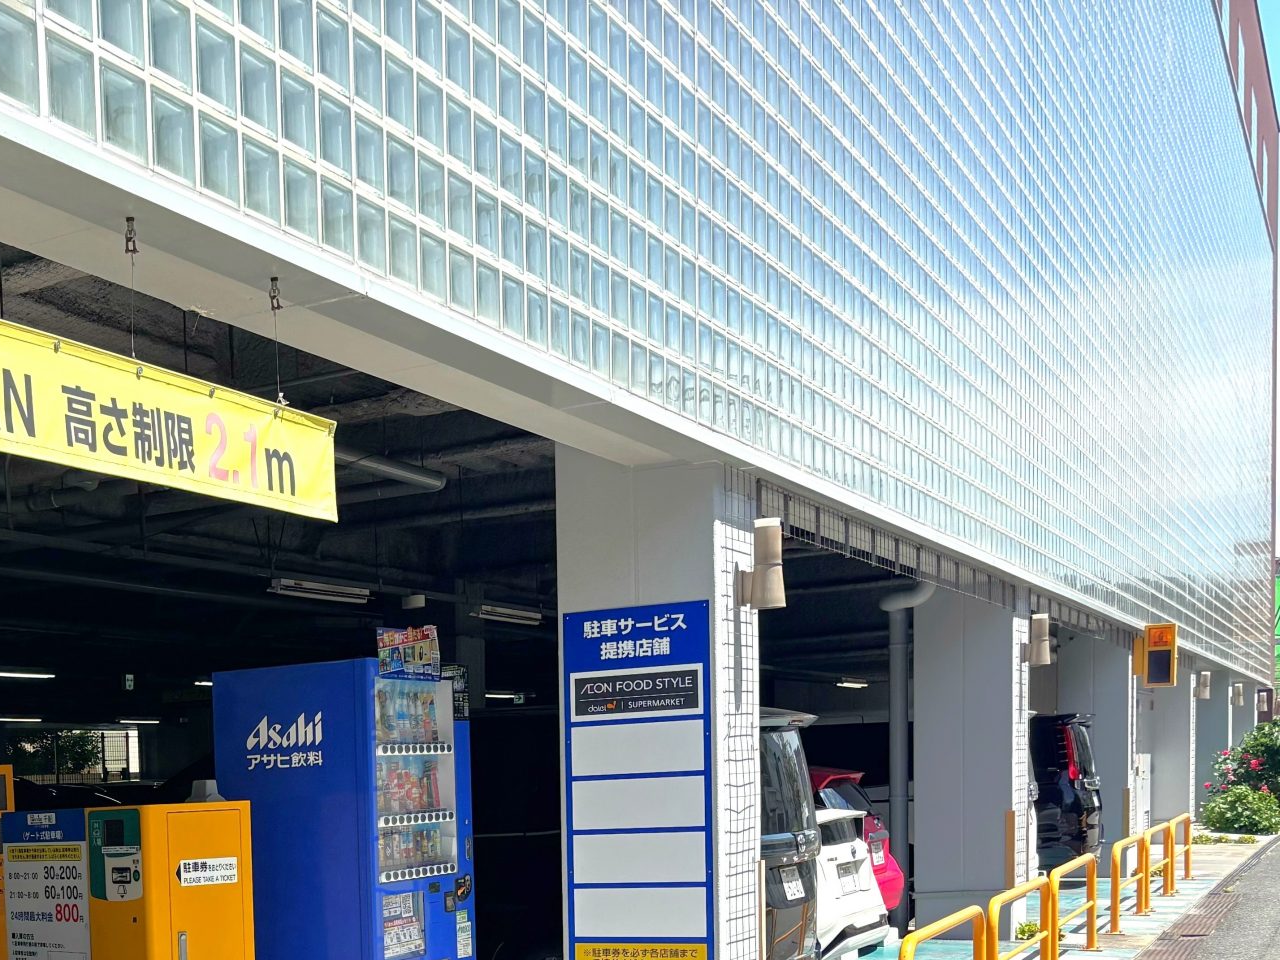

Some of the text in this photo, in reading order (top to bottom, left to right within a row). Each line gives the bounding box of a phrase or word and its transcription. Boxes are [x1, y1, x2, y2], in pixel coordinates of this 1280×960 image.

[61, 384, 196, 473] 高さ制限
[205, 411, 297, 497] 2.1m
[583, 613, 687, 639] 駐車サービス
[600, 637, 671, 660] 提携店舗
[616, 679, 653, 692] FOOD
[655, 676, 694, 690] STYLE
[628, 698, 686, 709] SUPERMARKET
[246, 710, 323, 751] Asahi
[246, 750, 323, 770] アサヒ飲料
[183, 876, 202, 884] PLEASE
[203, 875, 215, 883] TAKE
[583, 947, 699, 959] ※駐車券を必ず各店舗まで
